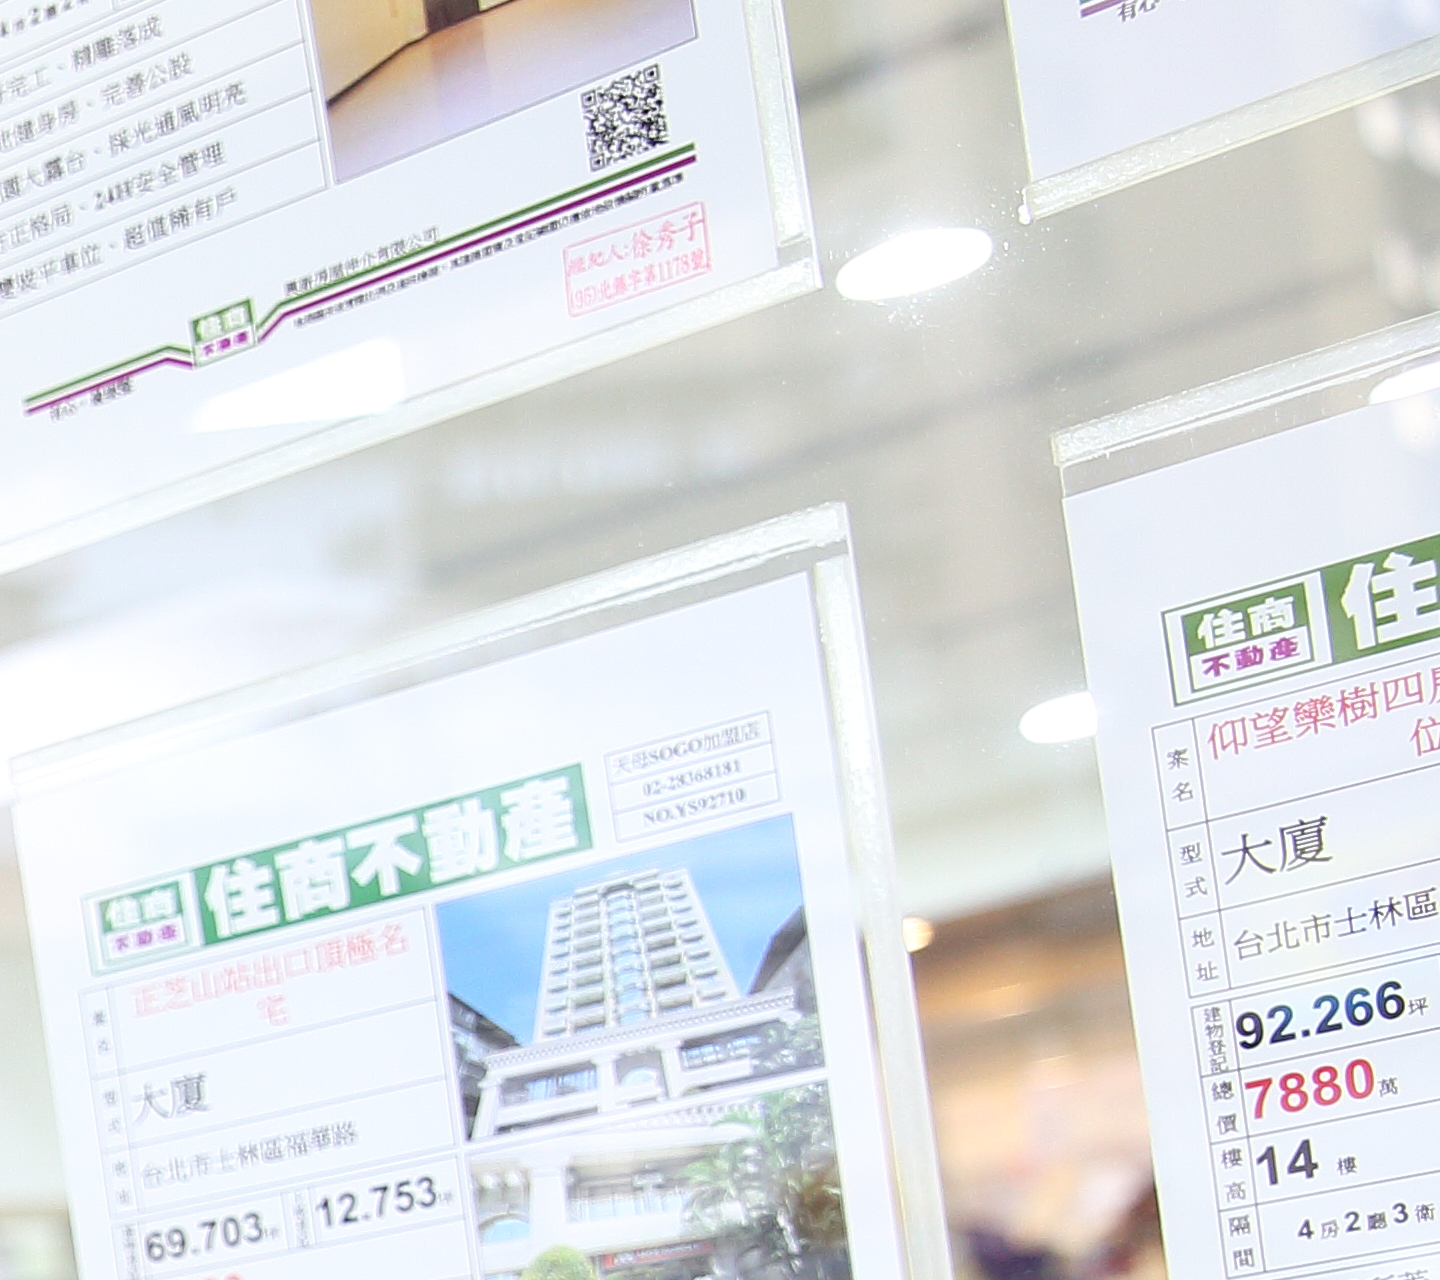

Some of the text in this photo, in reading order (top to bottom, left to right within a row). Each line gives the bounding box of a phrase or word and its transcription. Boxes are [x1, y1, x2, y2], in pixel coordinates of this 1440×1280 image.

[1197, 595, 1296, 650] 住商
[1201, 637, 1303, 680] 不動產
[202, 775, 579, 939] 住商不動產
[1220, 815, 1334, 889] 大廈
[131, 1069, 210, 1127] 大廈
[145, 1175, 438, 1263] 69.703 12.753
